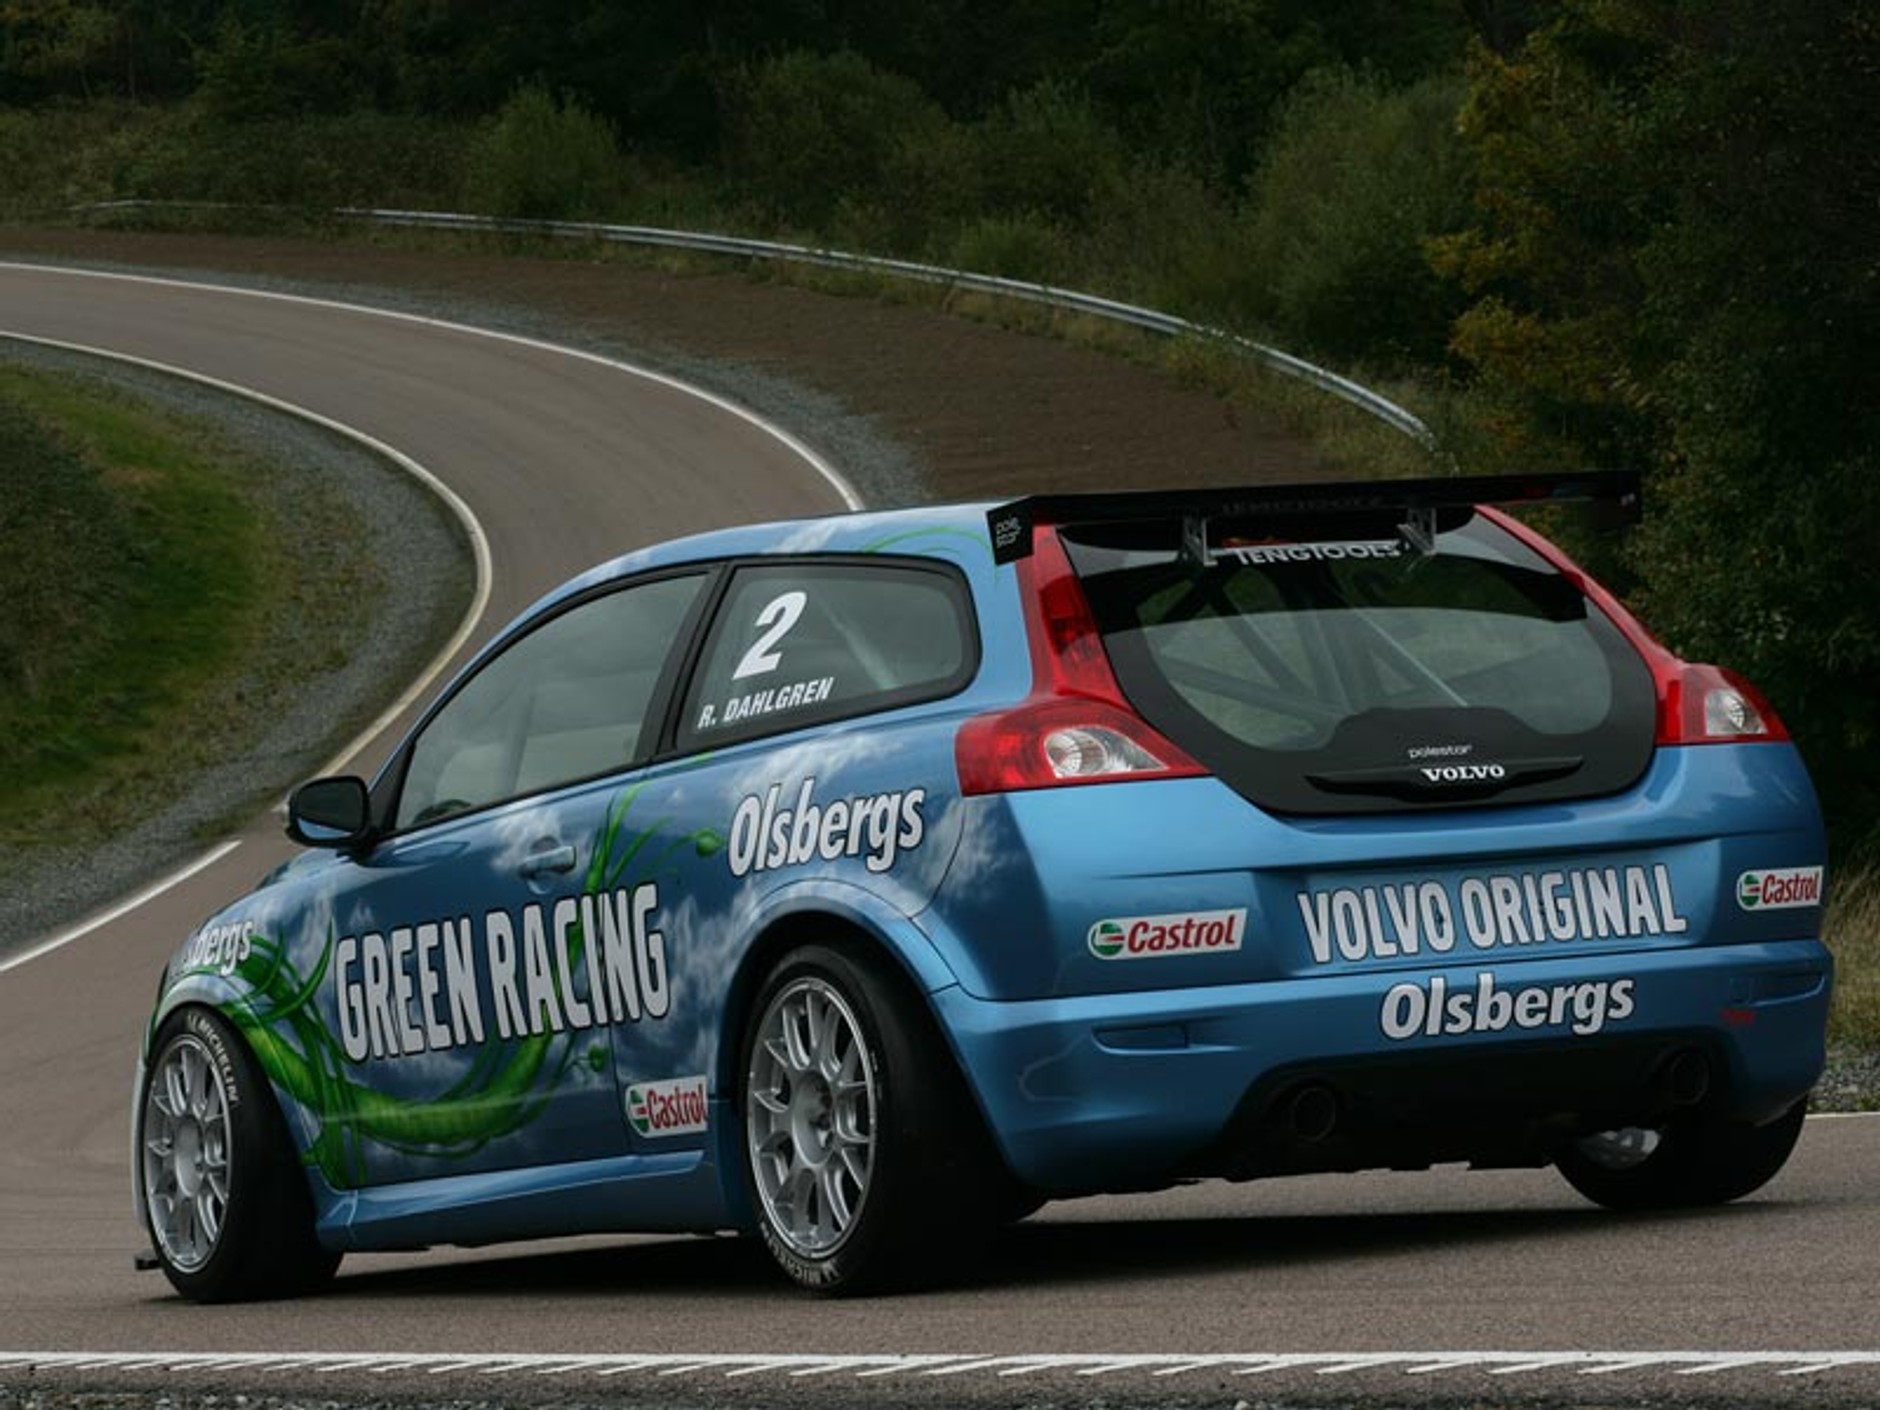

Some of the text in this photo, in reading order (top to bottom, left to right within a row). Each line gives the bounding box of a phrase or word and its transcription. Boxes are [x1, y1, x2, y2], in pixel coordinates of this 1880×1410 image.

[731, 591, 807, 681] 2
[697, 676, 835, 729] R. DAHLGREN
[1421, 764, 1505, 782] VOLVO
[729, 777, 926, 878] Olsbergs
[1297, 863, 1688, 963] VOLVO ORIGINAL
[1762, 872, 1820, 905] Castrol
[1127, 913, 1237, 954] Castrol
[334, 883, 670, 1063] GREEN RACING
[1380, 972, 1635, 1039] Olsbergs
[646, 1083, 709, 1130] Castrol
